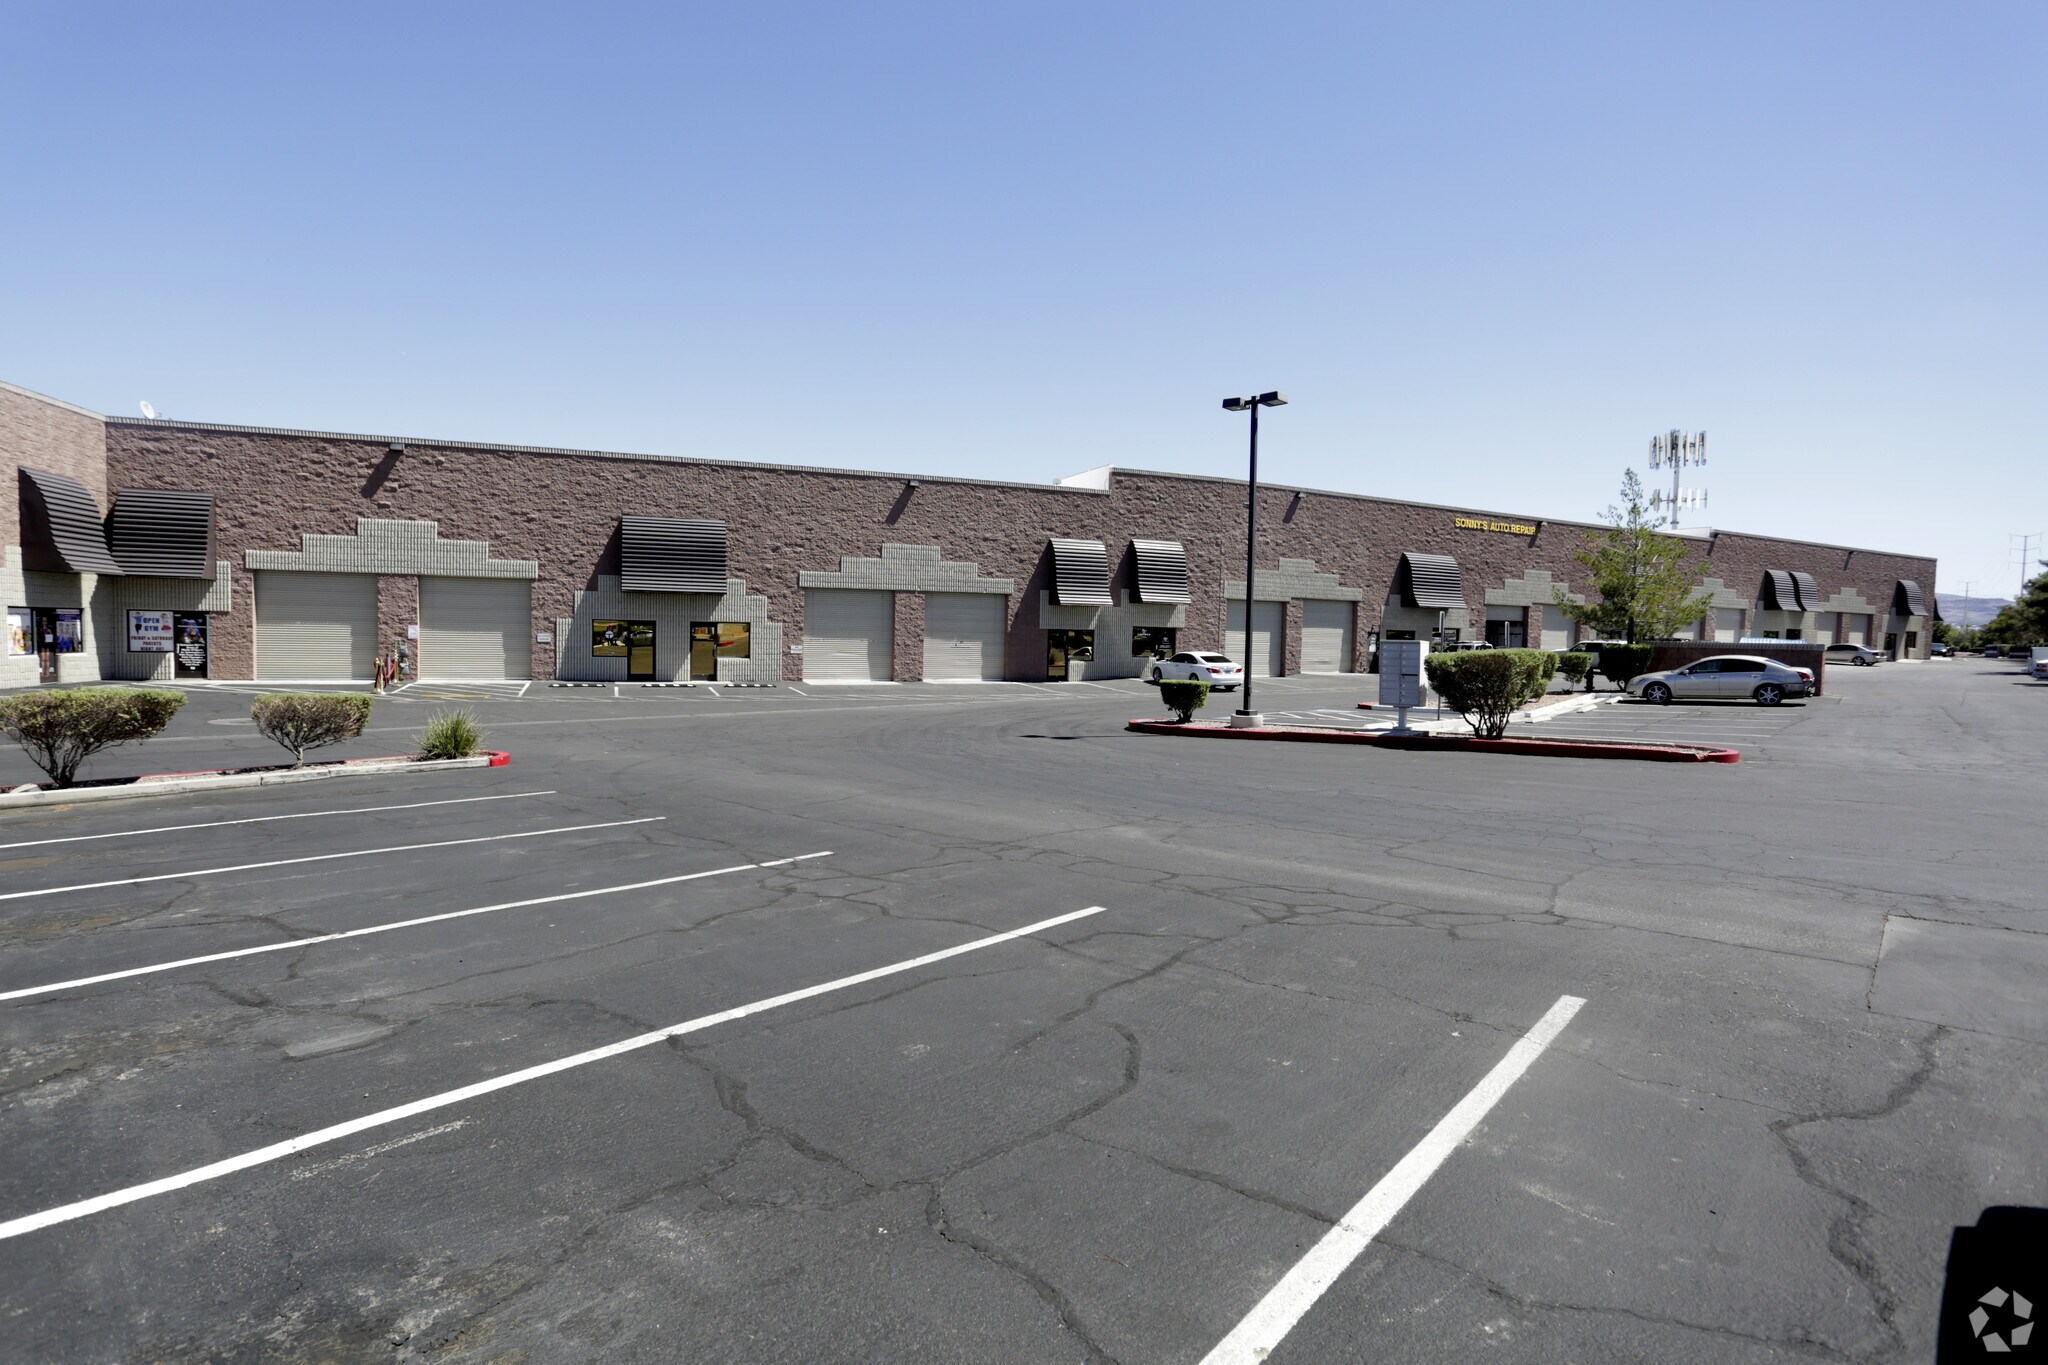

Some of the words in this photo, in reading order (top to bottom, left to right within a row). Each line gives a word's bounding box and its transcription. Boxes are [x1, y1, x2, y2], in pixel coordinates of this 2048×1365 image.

[1455, 518, 1488, 530] SONNY'S
[1490, 522, 1509, 532] AUTO
[1510, 524, 1536, 535] REPAIR
